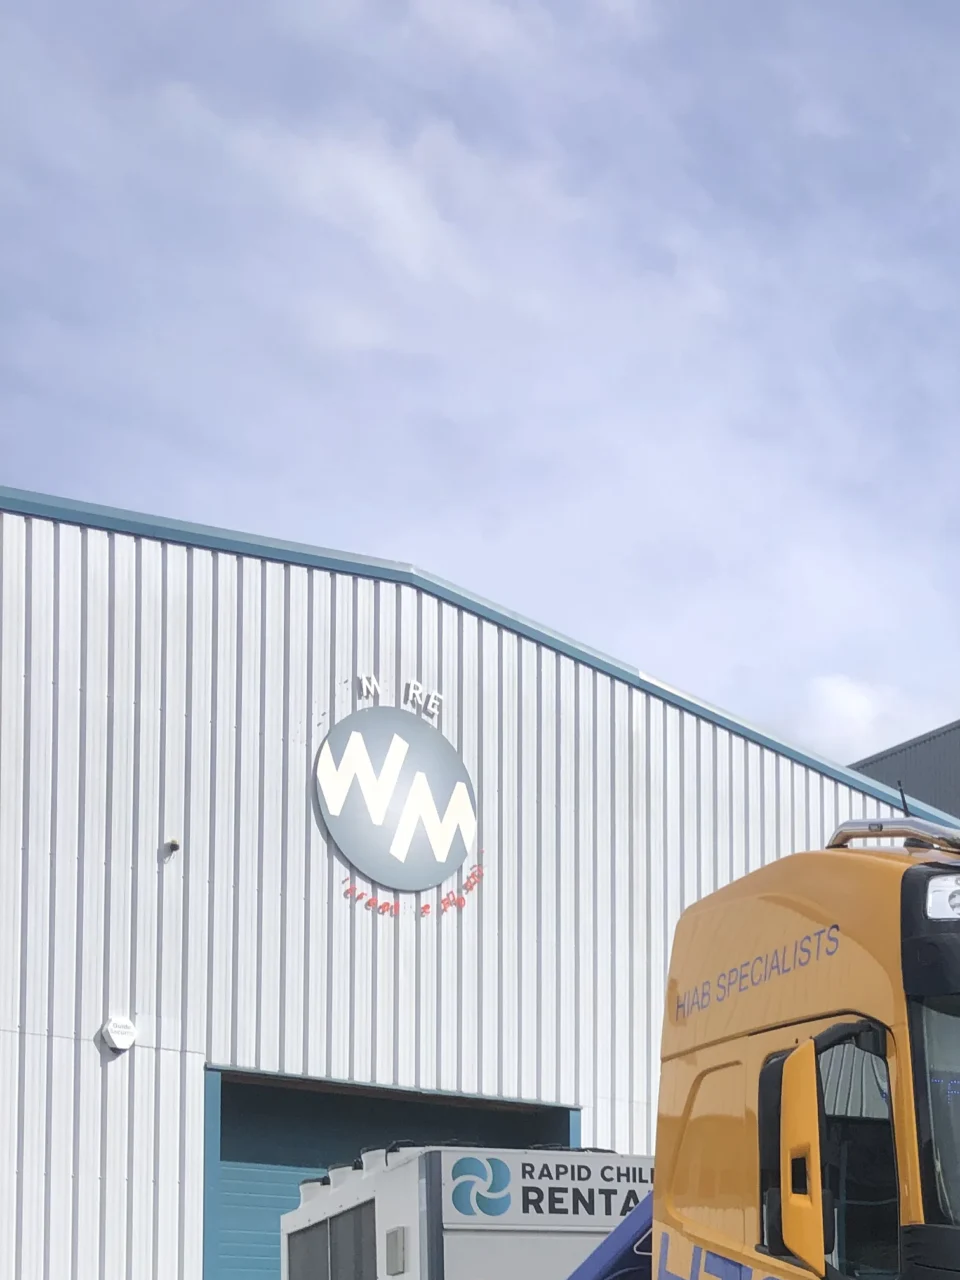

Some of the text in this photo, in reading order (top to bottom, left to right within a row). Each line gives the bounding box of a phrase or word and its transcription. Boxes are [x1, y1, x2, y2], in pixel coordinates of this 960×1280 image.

[317, 731, 477, 863] WM
[675, 924, 840, 1021] HIAB SPECIALISTS
[521, 1162, 592, 1181] RAPID
